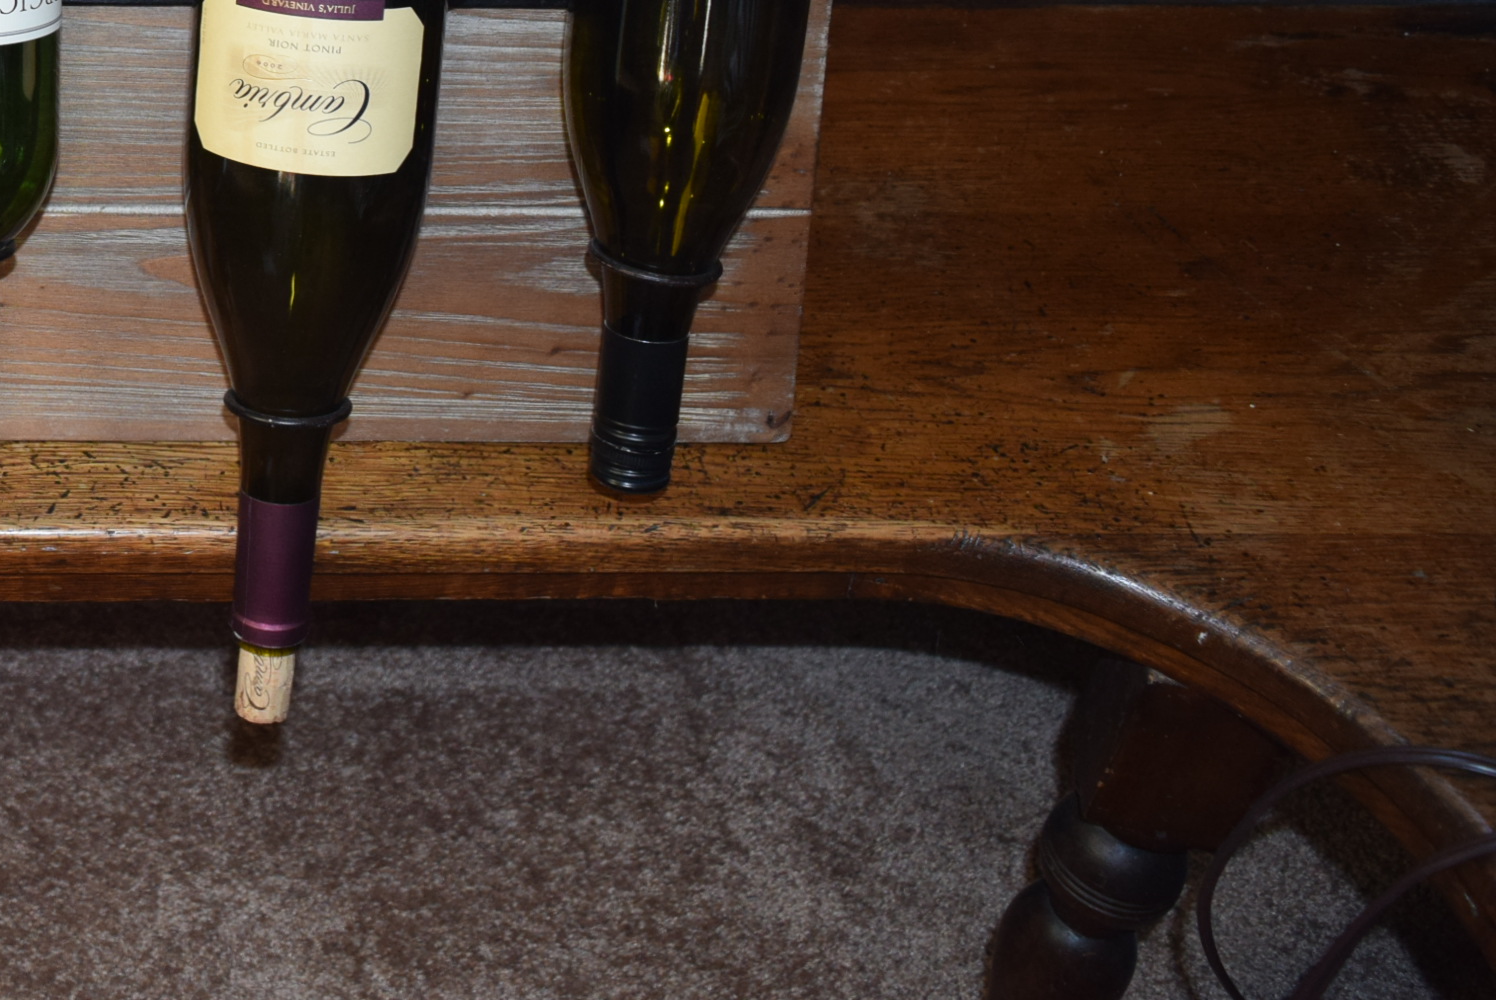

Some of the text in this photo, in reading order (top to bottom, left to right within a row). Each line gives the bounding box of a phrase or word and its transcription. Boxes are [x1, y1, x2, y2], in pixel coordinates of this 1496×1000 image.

[318, 4, 356, 15] JULIA'S
[268, 38, 342, 54] PINOT NOIR
[229, 78, 372, 144] Cambria
[255, 141, 336, 158] ESTATE BOTTLED
